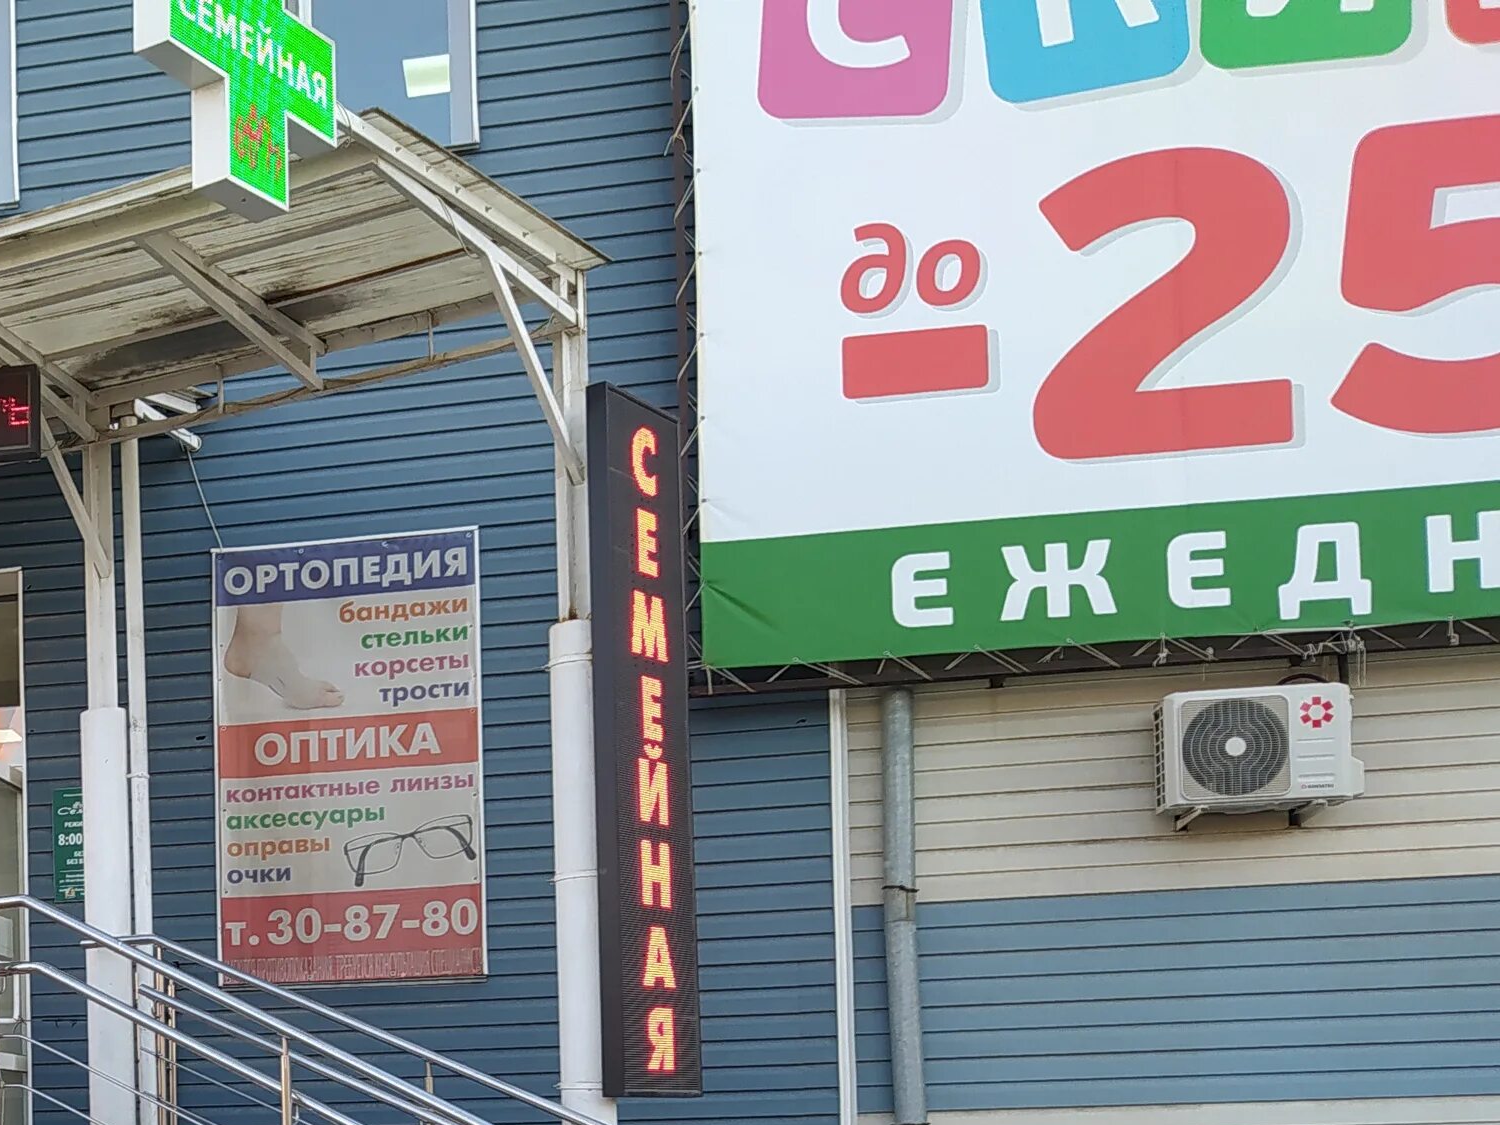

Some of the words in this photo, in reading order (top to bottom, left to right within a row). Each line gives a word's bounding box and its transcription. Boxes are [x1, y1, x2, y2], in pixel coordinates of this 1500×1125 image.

[178, 0, 328, 109] СЕМЕЙНАЯ
[840, 222, 982, 313] до
[223, 546, 468, 596] ОРТОПЕДИЯ
[338, 596, 469, 624] бандажи
[360, 624, 469, 650] стельки
[354, 653, 470, 678] корсеты
[378, 681, 470, 707] трости
[254, 721, 442, 767] ОПТИКА
[628, 424, 677, 1074] СЕМЕЙНАЯ
[226, 779, 381, 804] контактные
[389, 773, 475, 793] линзы
[226, 806, 385, 830] аксессуары
[58, 833, 83, 846] 8:00
[226, 837, 330, 861] оправы
[226, 866, 292, 884] очки
